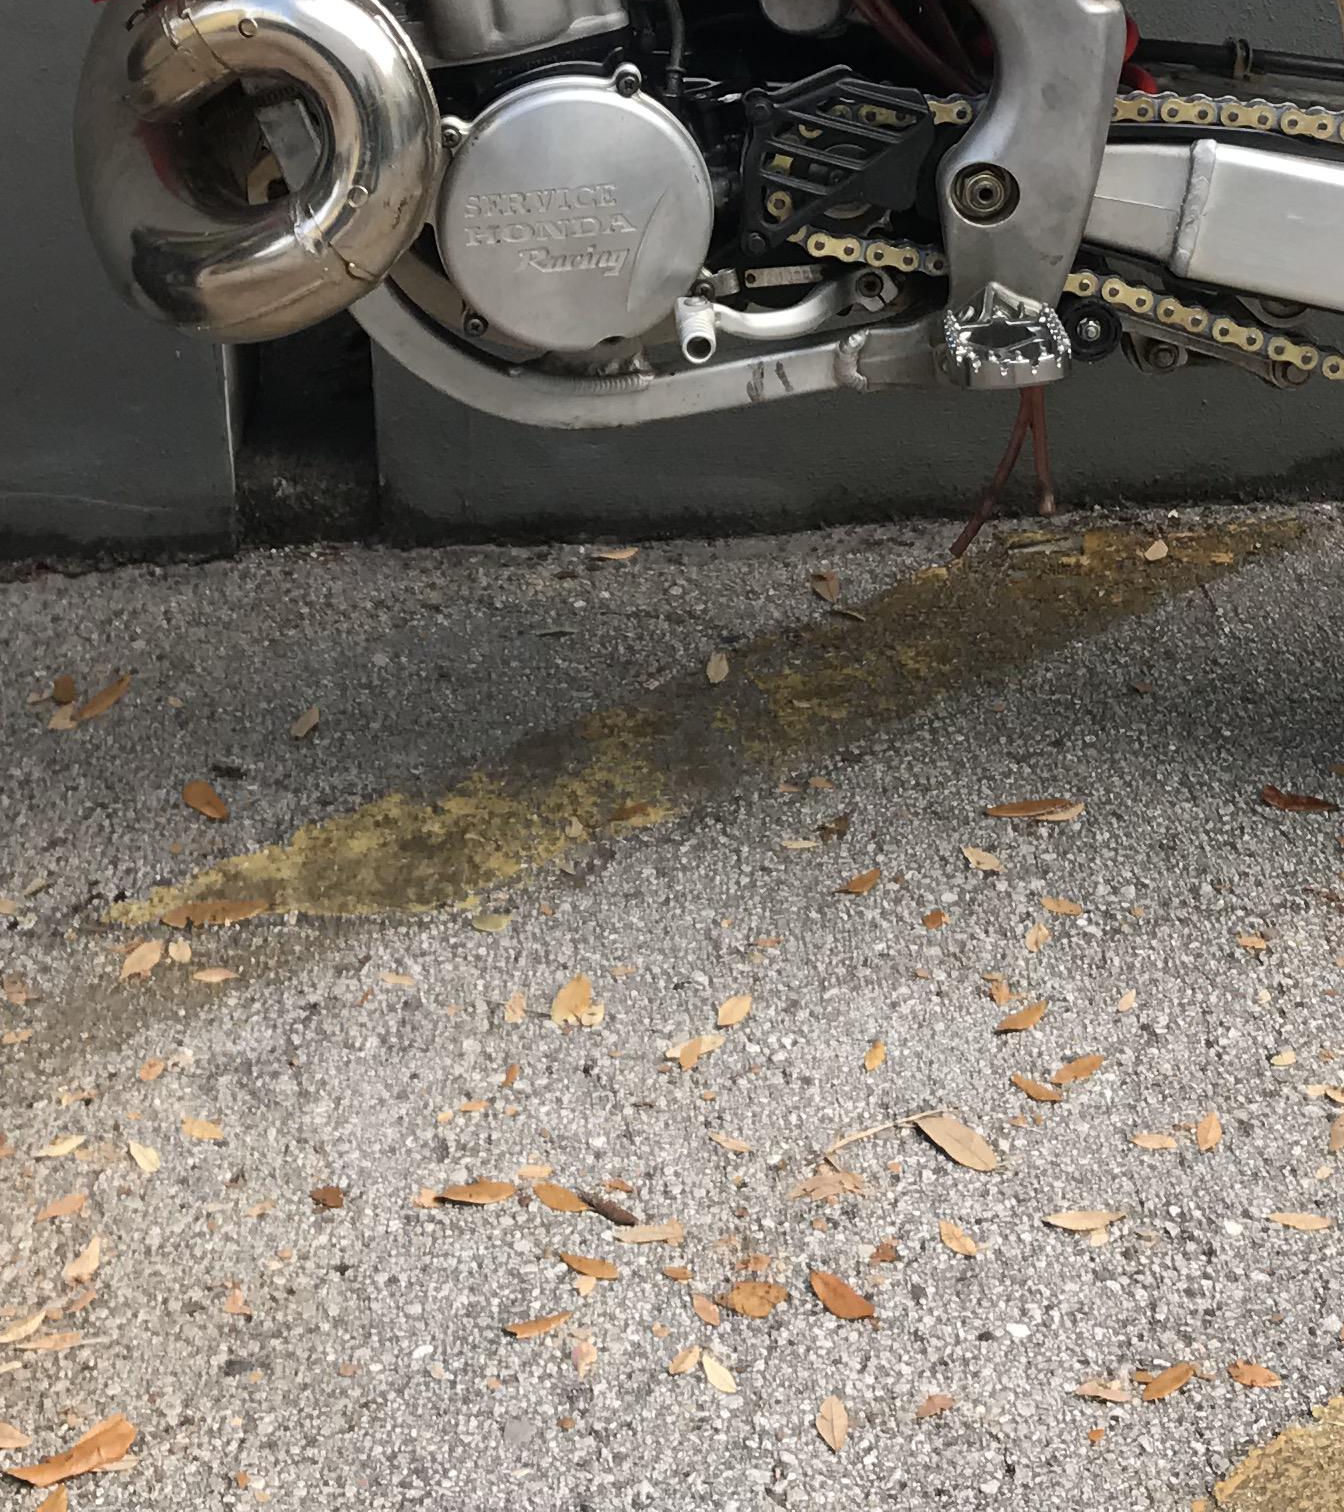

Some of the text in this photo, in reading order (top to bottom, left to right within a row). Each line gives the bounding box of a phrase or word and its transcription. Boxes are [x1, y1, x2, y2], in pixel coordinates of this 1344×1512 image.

[464, 183, 619, 220] SERVICE
[465, 213, 639, 248] HONDA
[516, 245, 630, 277] Racing
